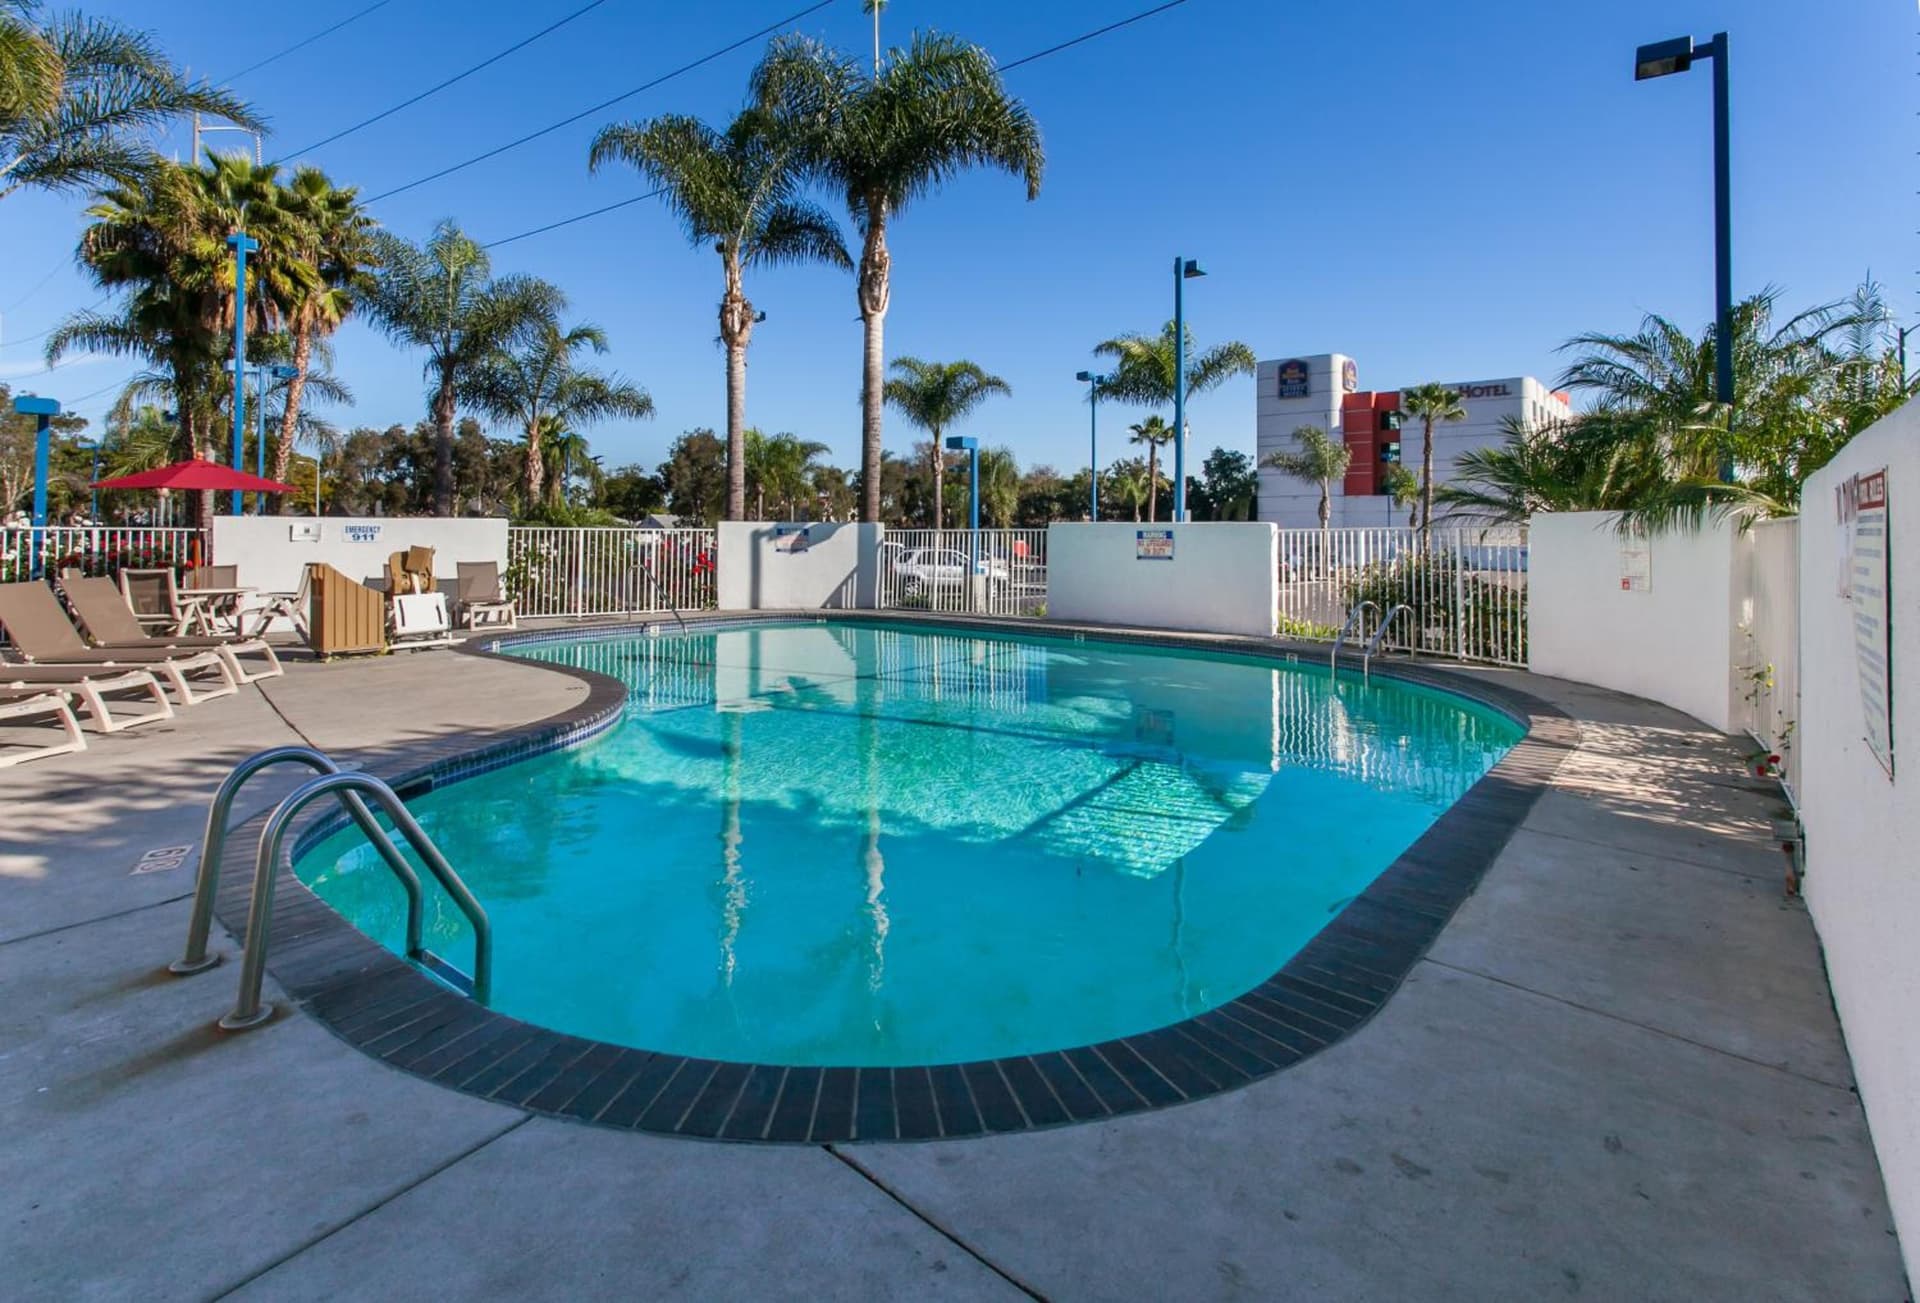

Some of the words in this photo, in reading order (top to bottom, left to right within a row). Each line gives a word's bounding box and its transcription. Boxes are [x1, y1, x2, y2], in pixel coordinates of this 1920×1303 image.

[1459, 384, 1512, 398] HOTEL
[345, 526, 381, 534] EMERGENCY
[351, 533, 375, 541] 911
